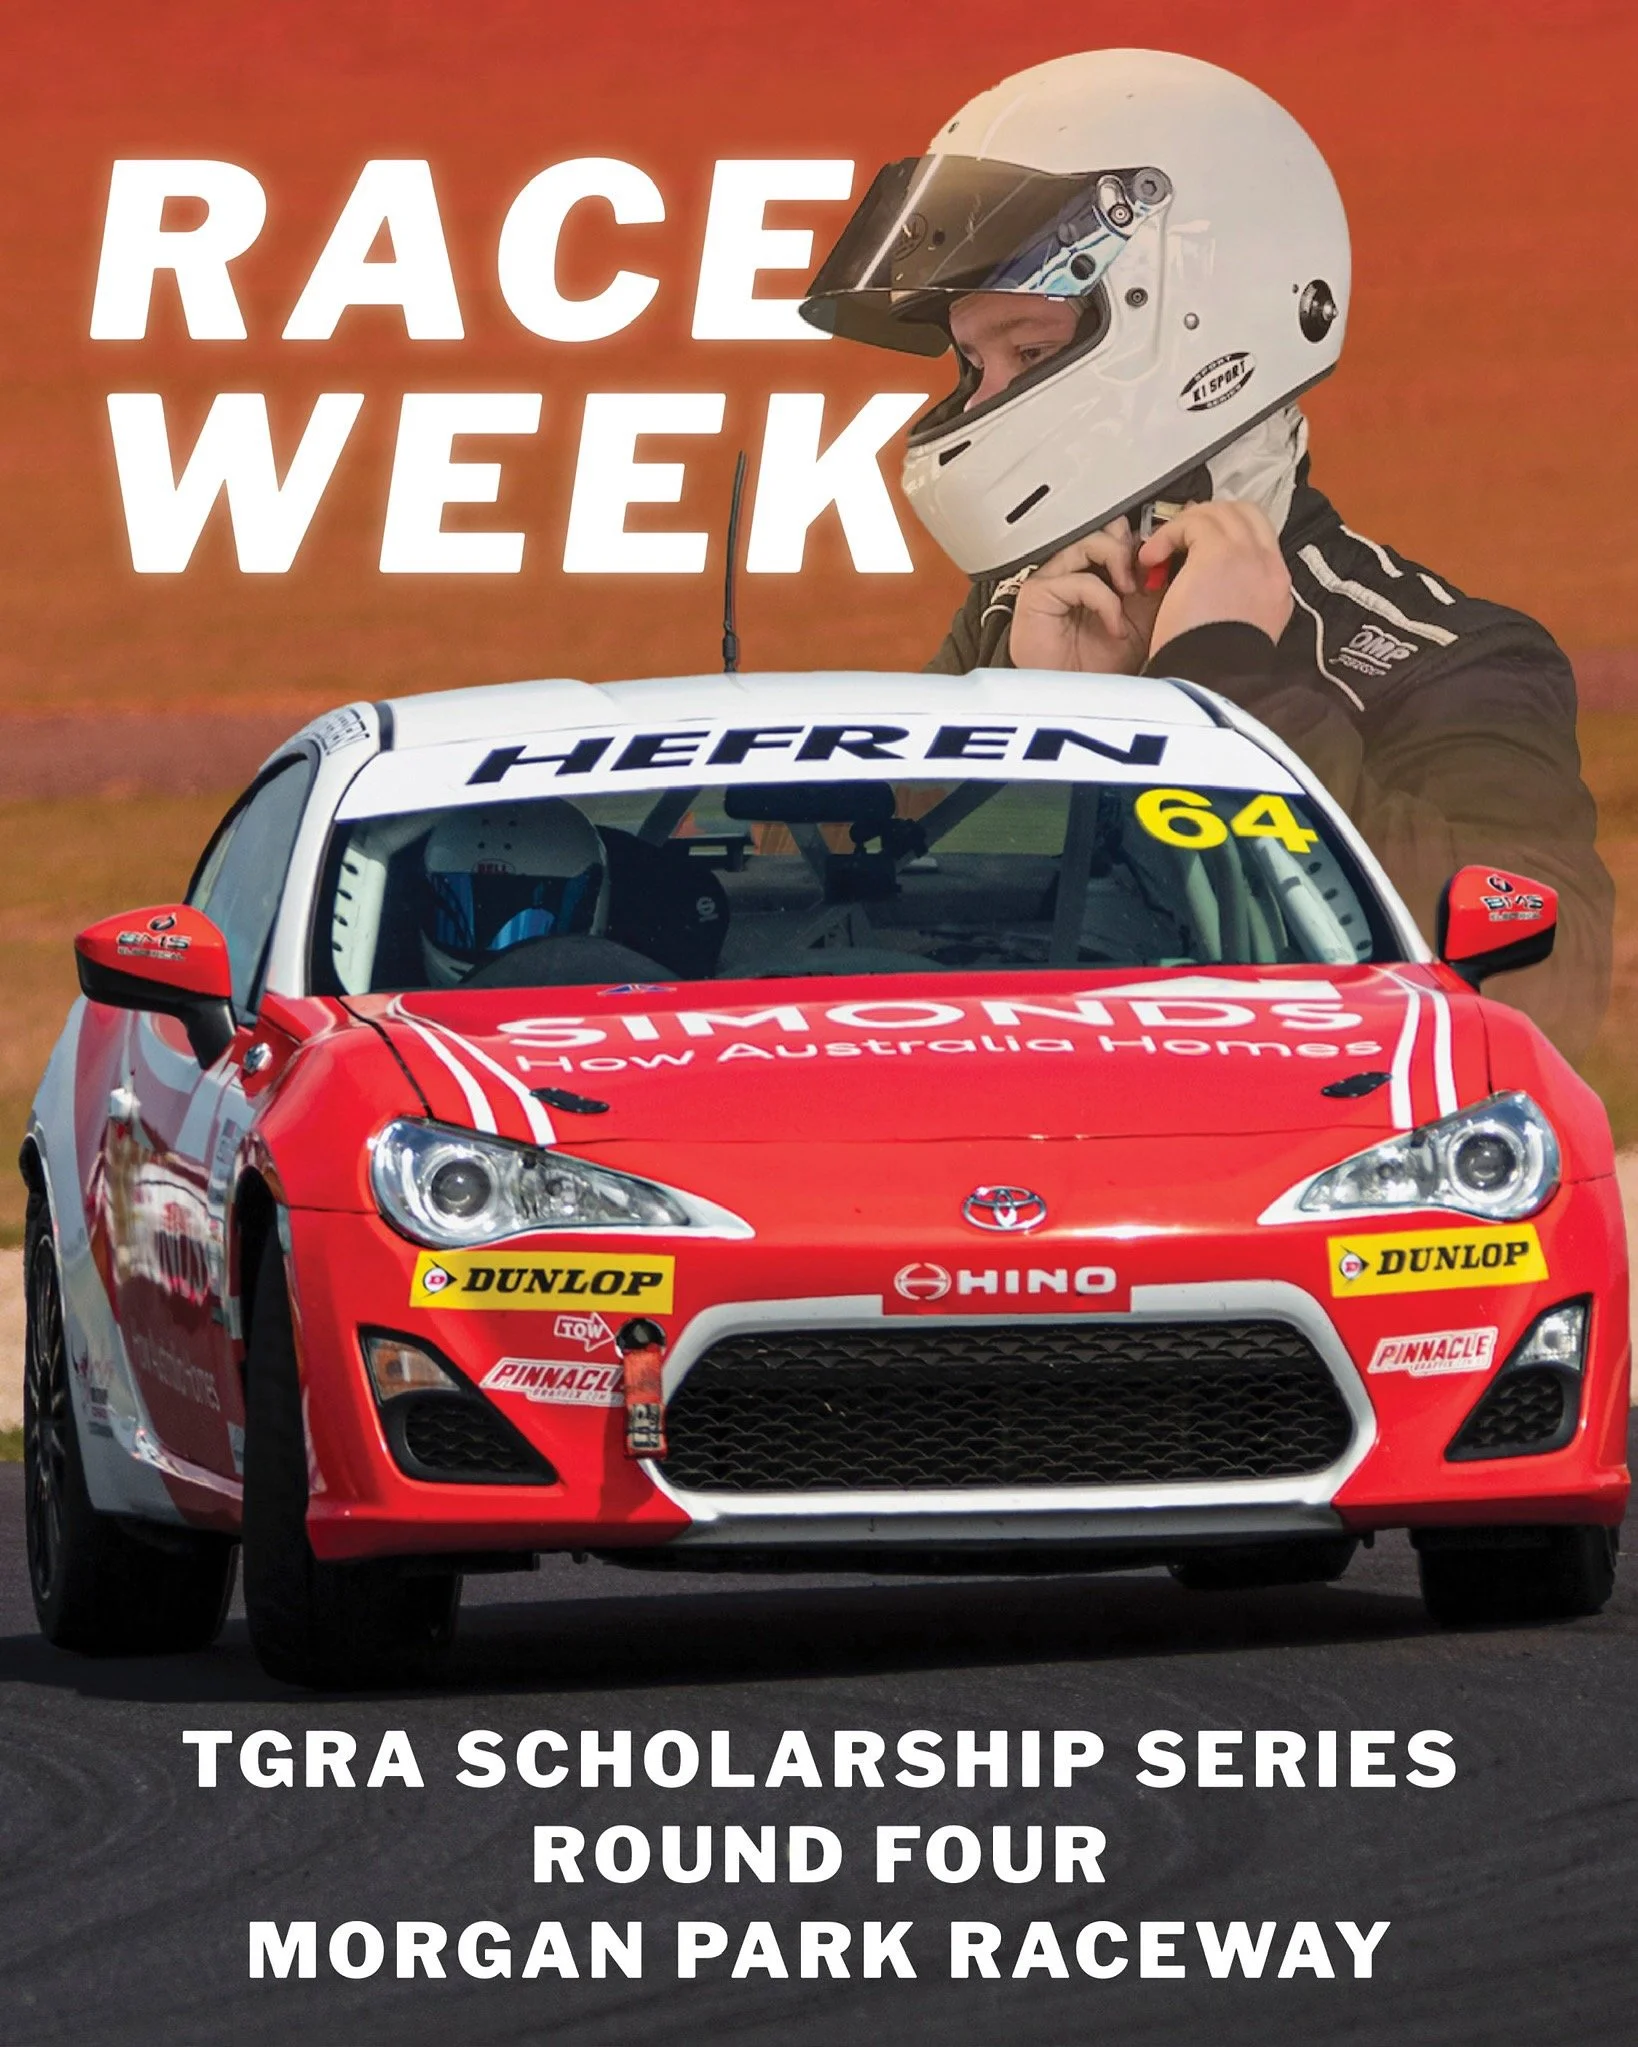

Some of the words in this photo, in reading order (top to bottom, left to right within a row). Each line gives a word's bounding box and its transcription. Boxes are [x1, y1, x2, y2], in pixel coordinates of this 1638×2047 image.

[1209, 360, 1246, 393] SPORT
[1348, 630, 1411, 662] OMP
[465, 724, 1170, 786] HEFREN
[1134, 787, 1320, 855] 64
[497, 1000, 1363, 1049] SIMONDS
[515, 1050, 695, 1074] How
[716, 1034, 1075, 1063] Australia
[1097, 1034, 1383, 1059] Homes
[1376, 1240, 1530, 1276] DUNLOP
[461, 1267, 664, 1297] DUNLOP
[956, 1265, 1118, 1295] HINO
[561, 1321, 604, 1339] TOW
[1376, 1335, 1490, 1367] PINNACLE
